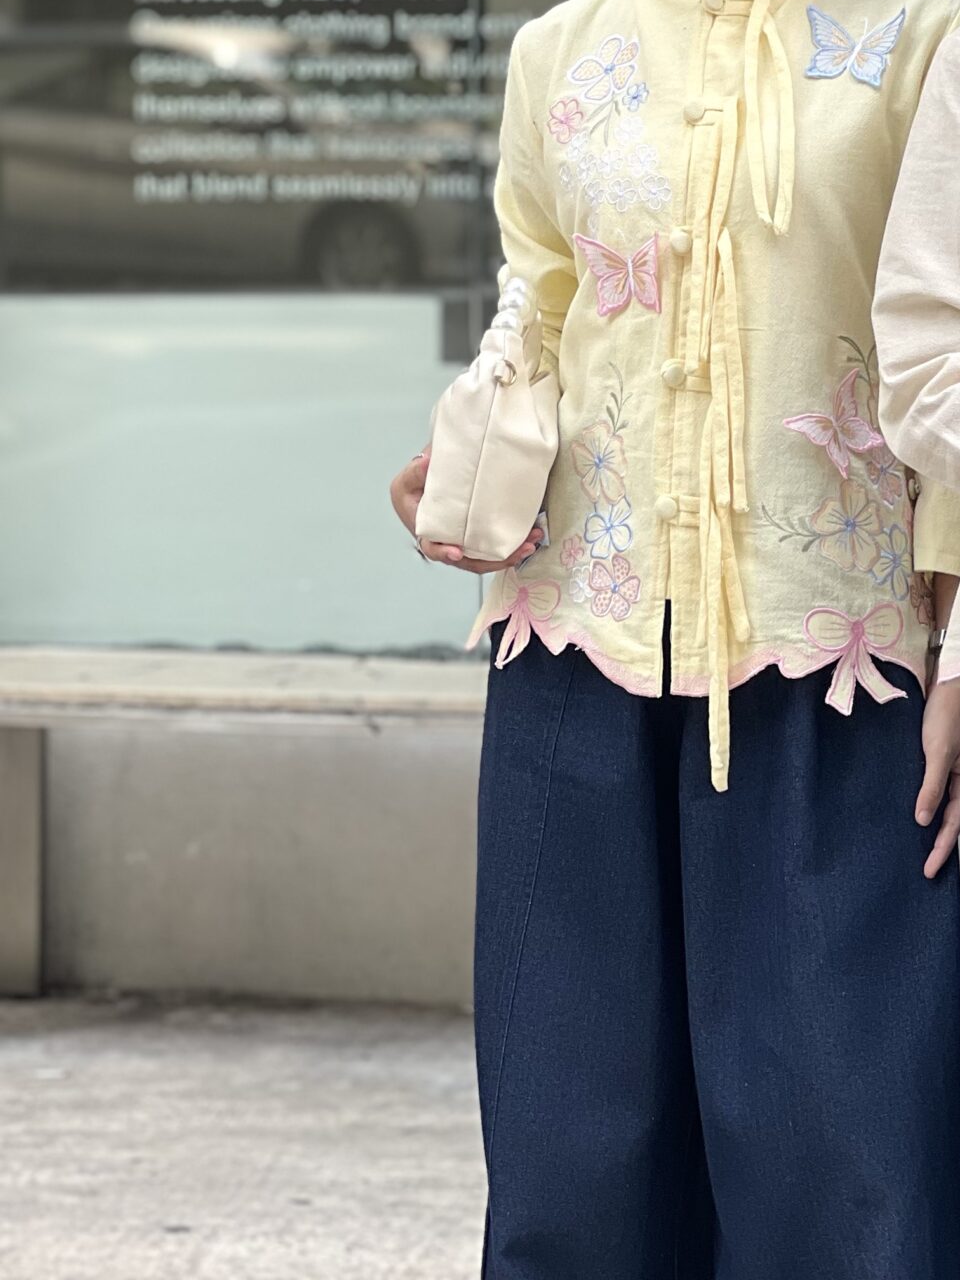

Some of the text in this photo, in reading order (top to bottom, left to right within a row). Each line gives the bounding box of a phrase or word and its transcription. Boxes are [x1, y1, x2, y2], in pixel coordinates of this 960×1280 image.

[133, 172, 188, 203] that
[191, 172, 268, 203] blend
[271, 172, 418, 207] seamlessly
